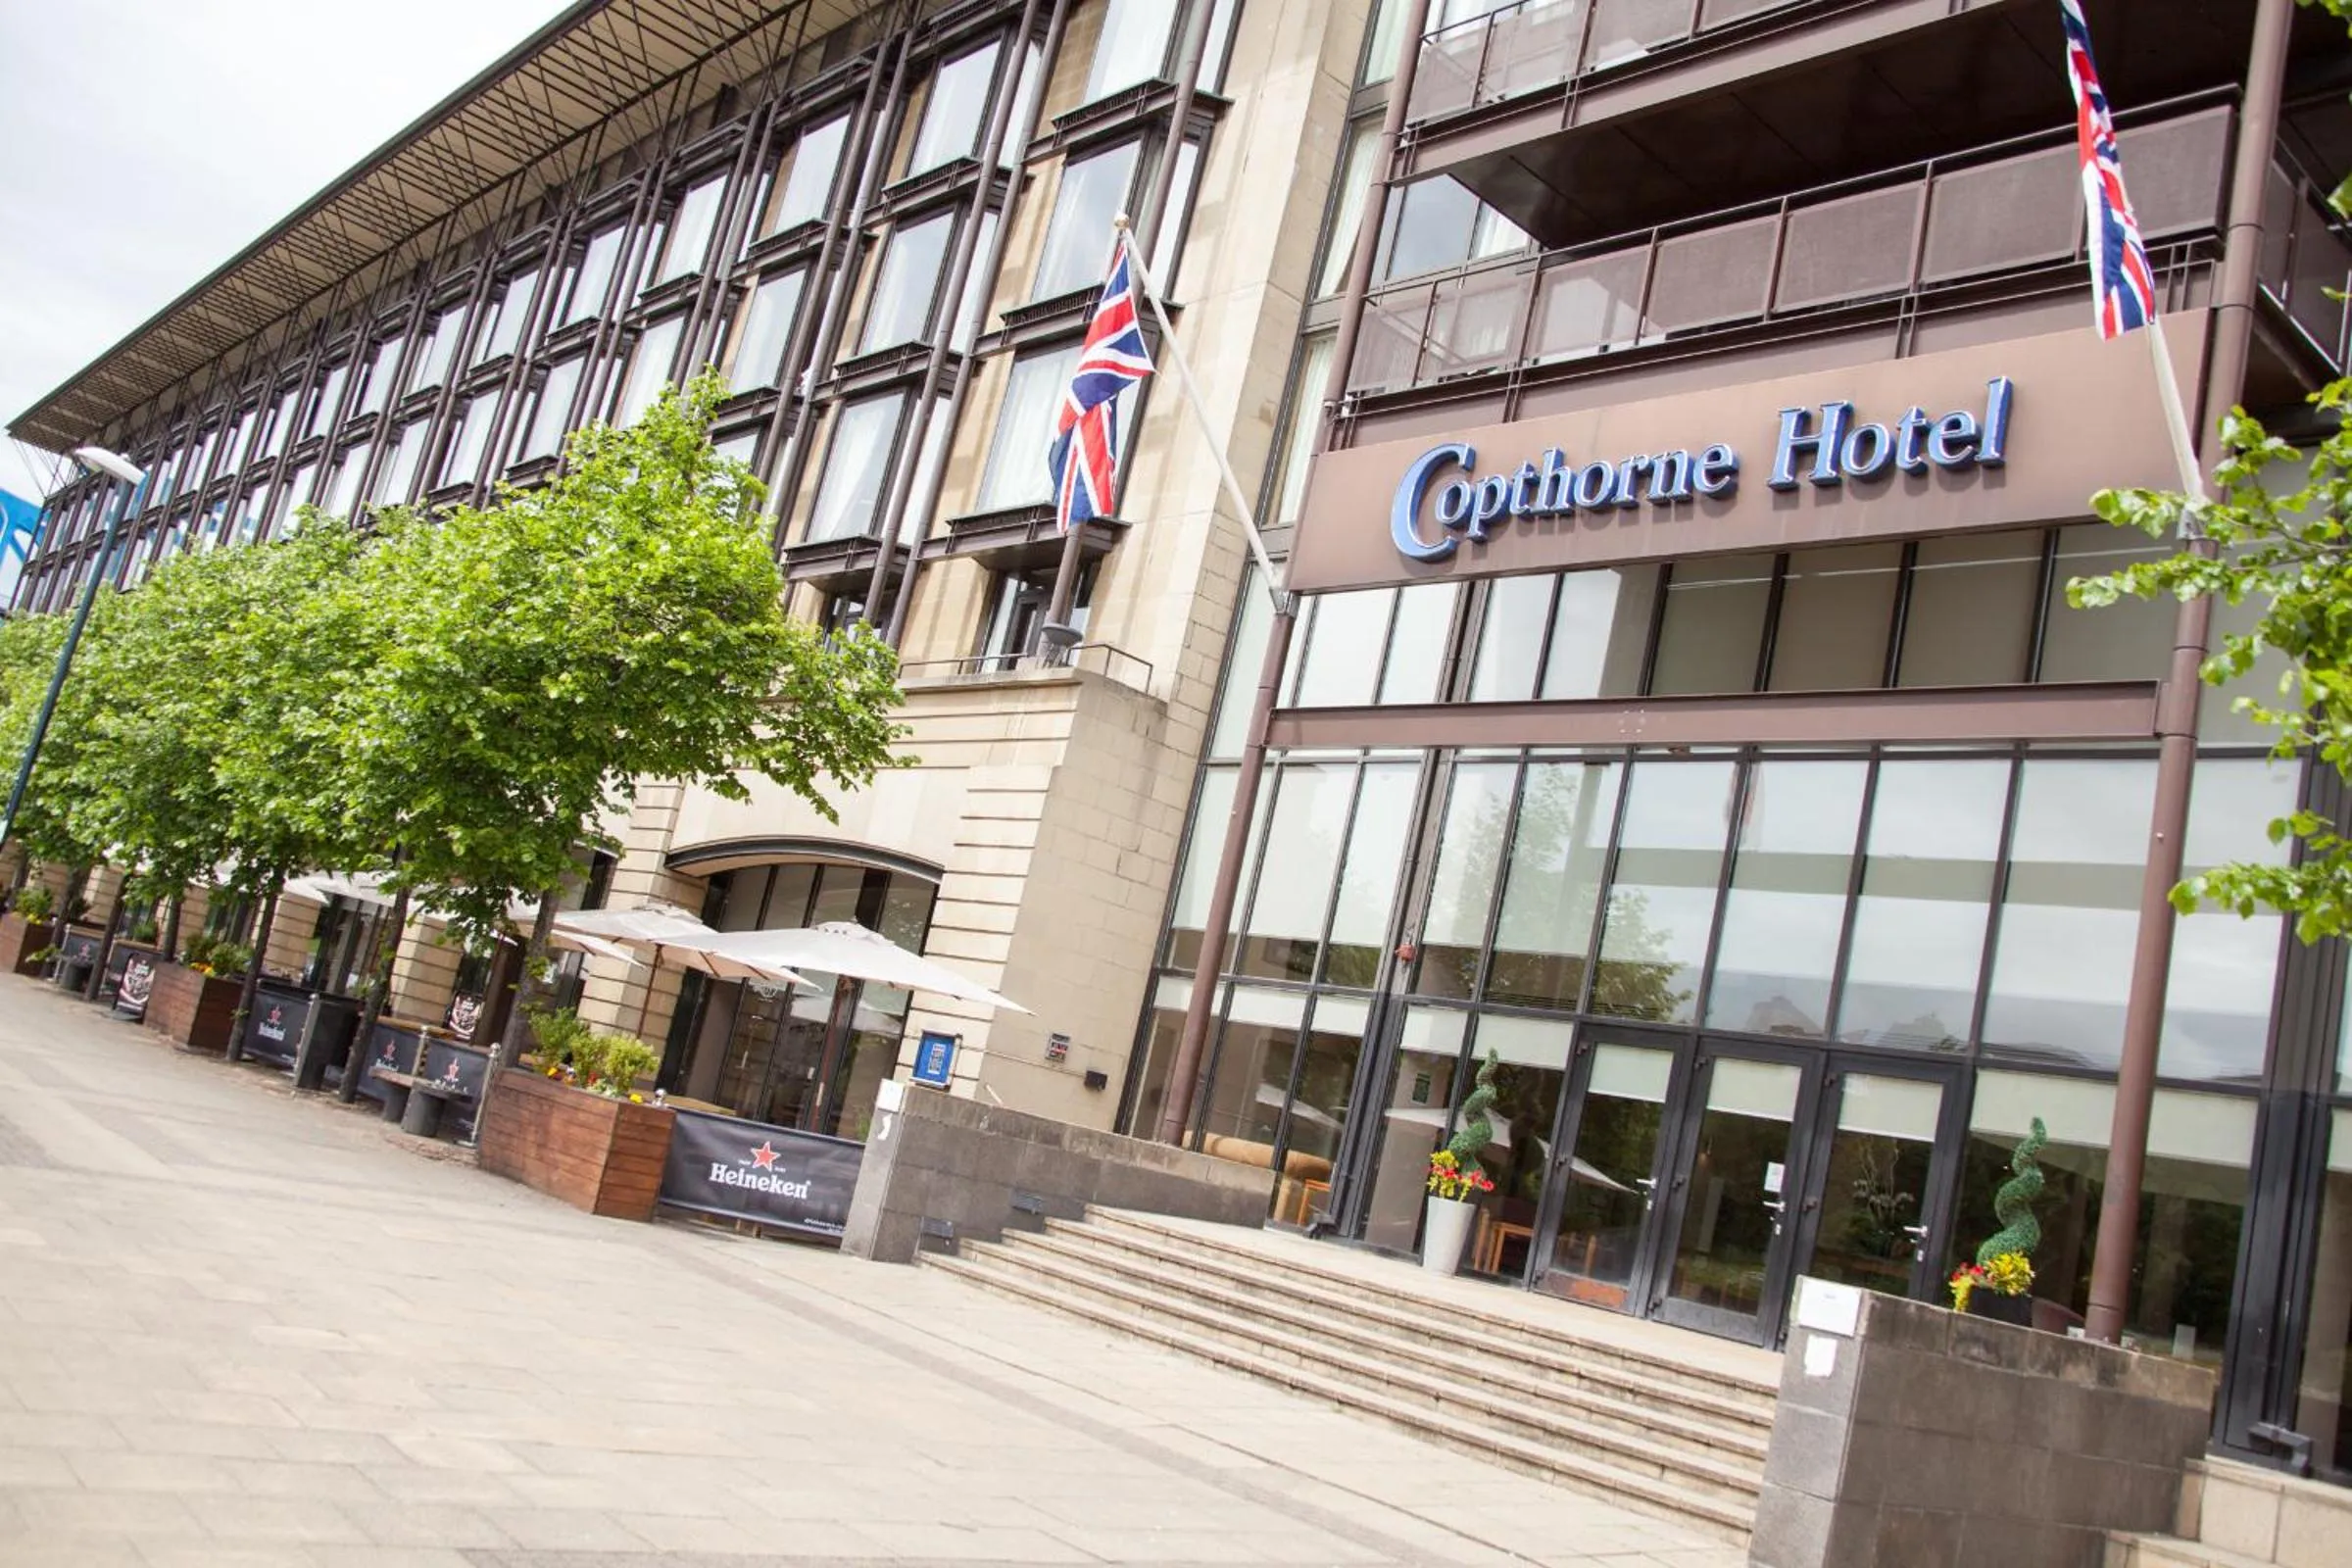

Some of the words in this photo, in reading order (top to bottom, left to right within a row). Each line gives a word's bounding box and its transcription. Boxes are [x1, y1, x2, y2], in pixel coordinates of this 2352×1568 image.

[1391, 443, 1740, 561] Copthorne
[1767, 376, 2014, 490] Hotel
[709, 1162, 810, 1200] Heineken
